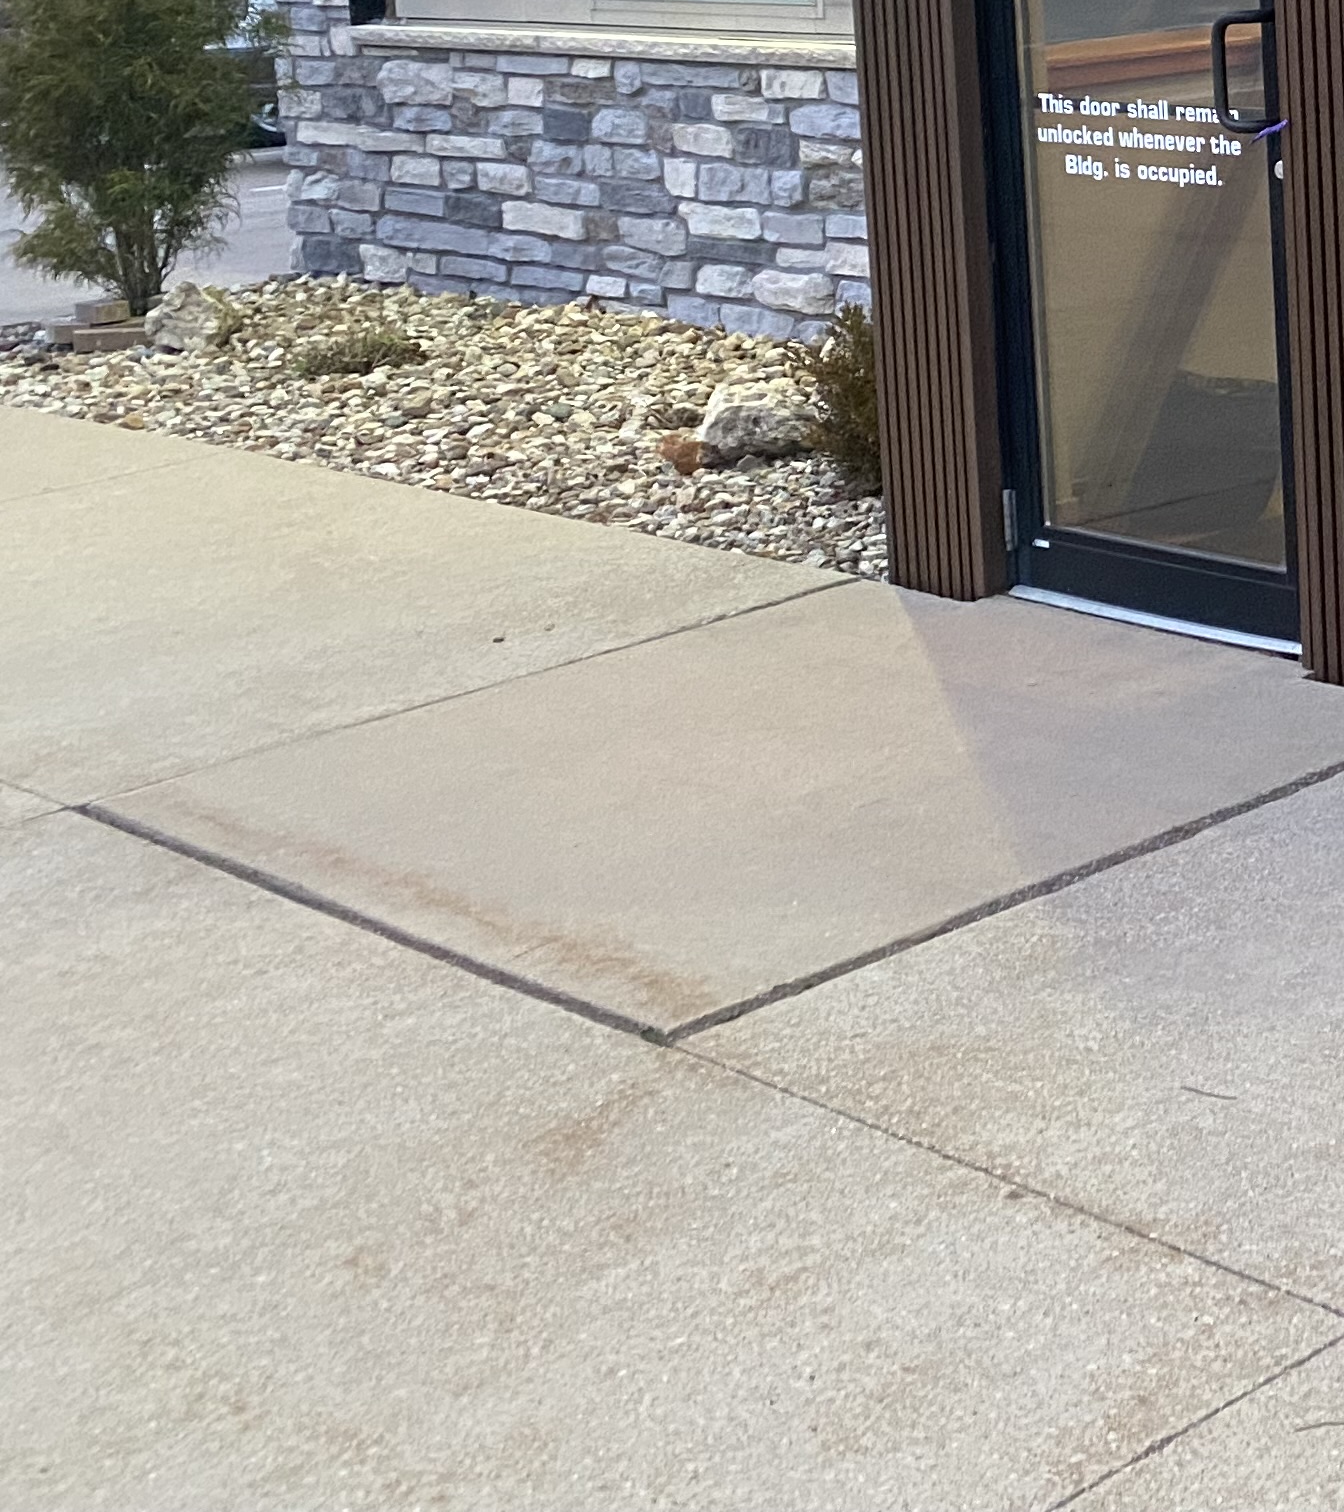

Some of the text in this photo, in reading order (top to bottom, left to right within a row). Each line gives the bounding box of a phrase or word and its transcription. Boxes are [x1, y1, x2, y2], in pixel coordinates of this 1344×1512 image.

[1037, 92, 1239, 123] This door shall reman
[1037, 124, 1242, 156] unlocked whenever the
[1065, 154, 1223, 188] Bldg. is occupied.
